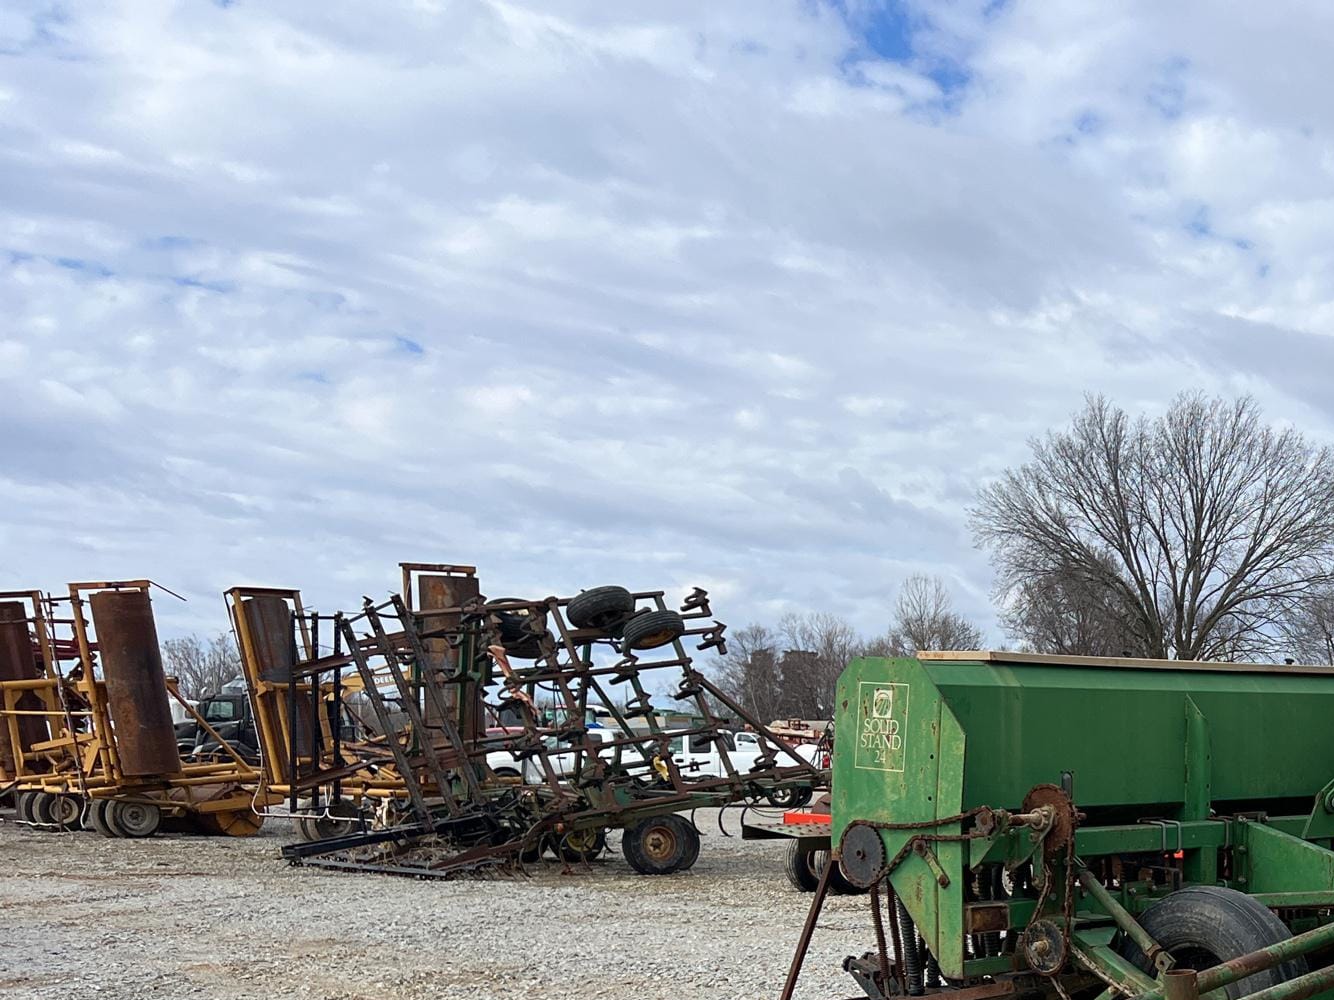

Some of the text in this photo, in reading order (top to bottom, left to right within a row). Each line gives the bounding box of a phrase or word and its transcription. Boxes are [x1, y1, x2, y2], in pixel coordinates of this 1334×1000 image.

[864, 718, 900, 735] SOLID
[861, 733, 902, 750] STAND
[874, 750, 886, 763] 24
